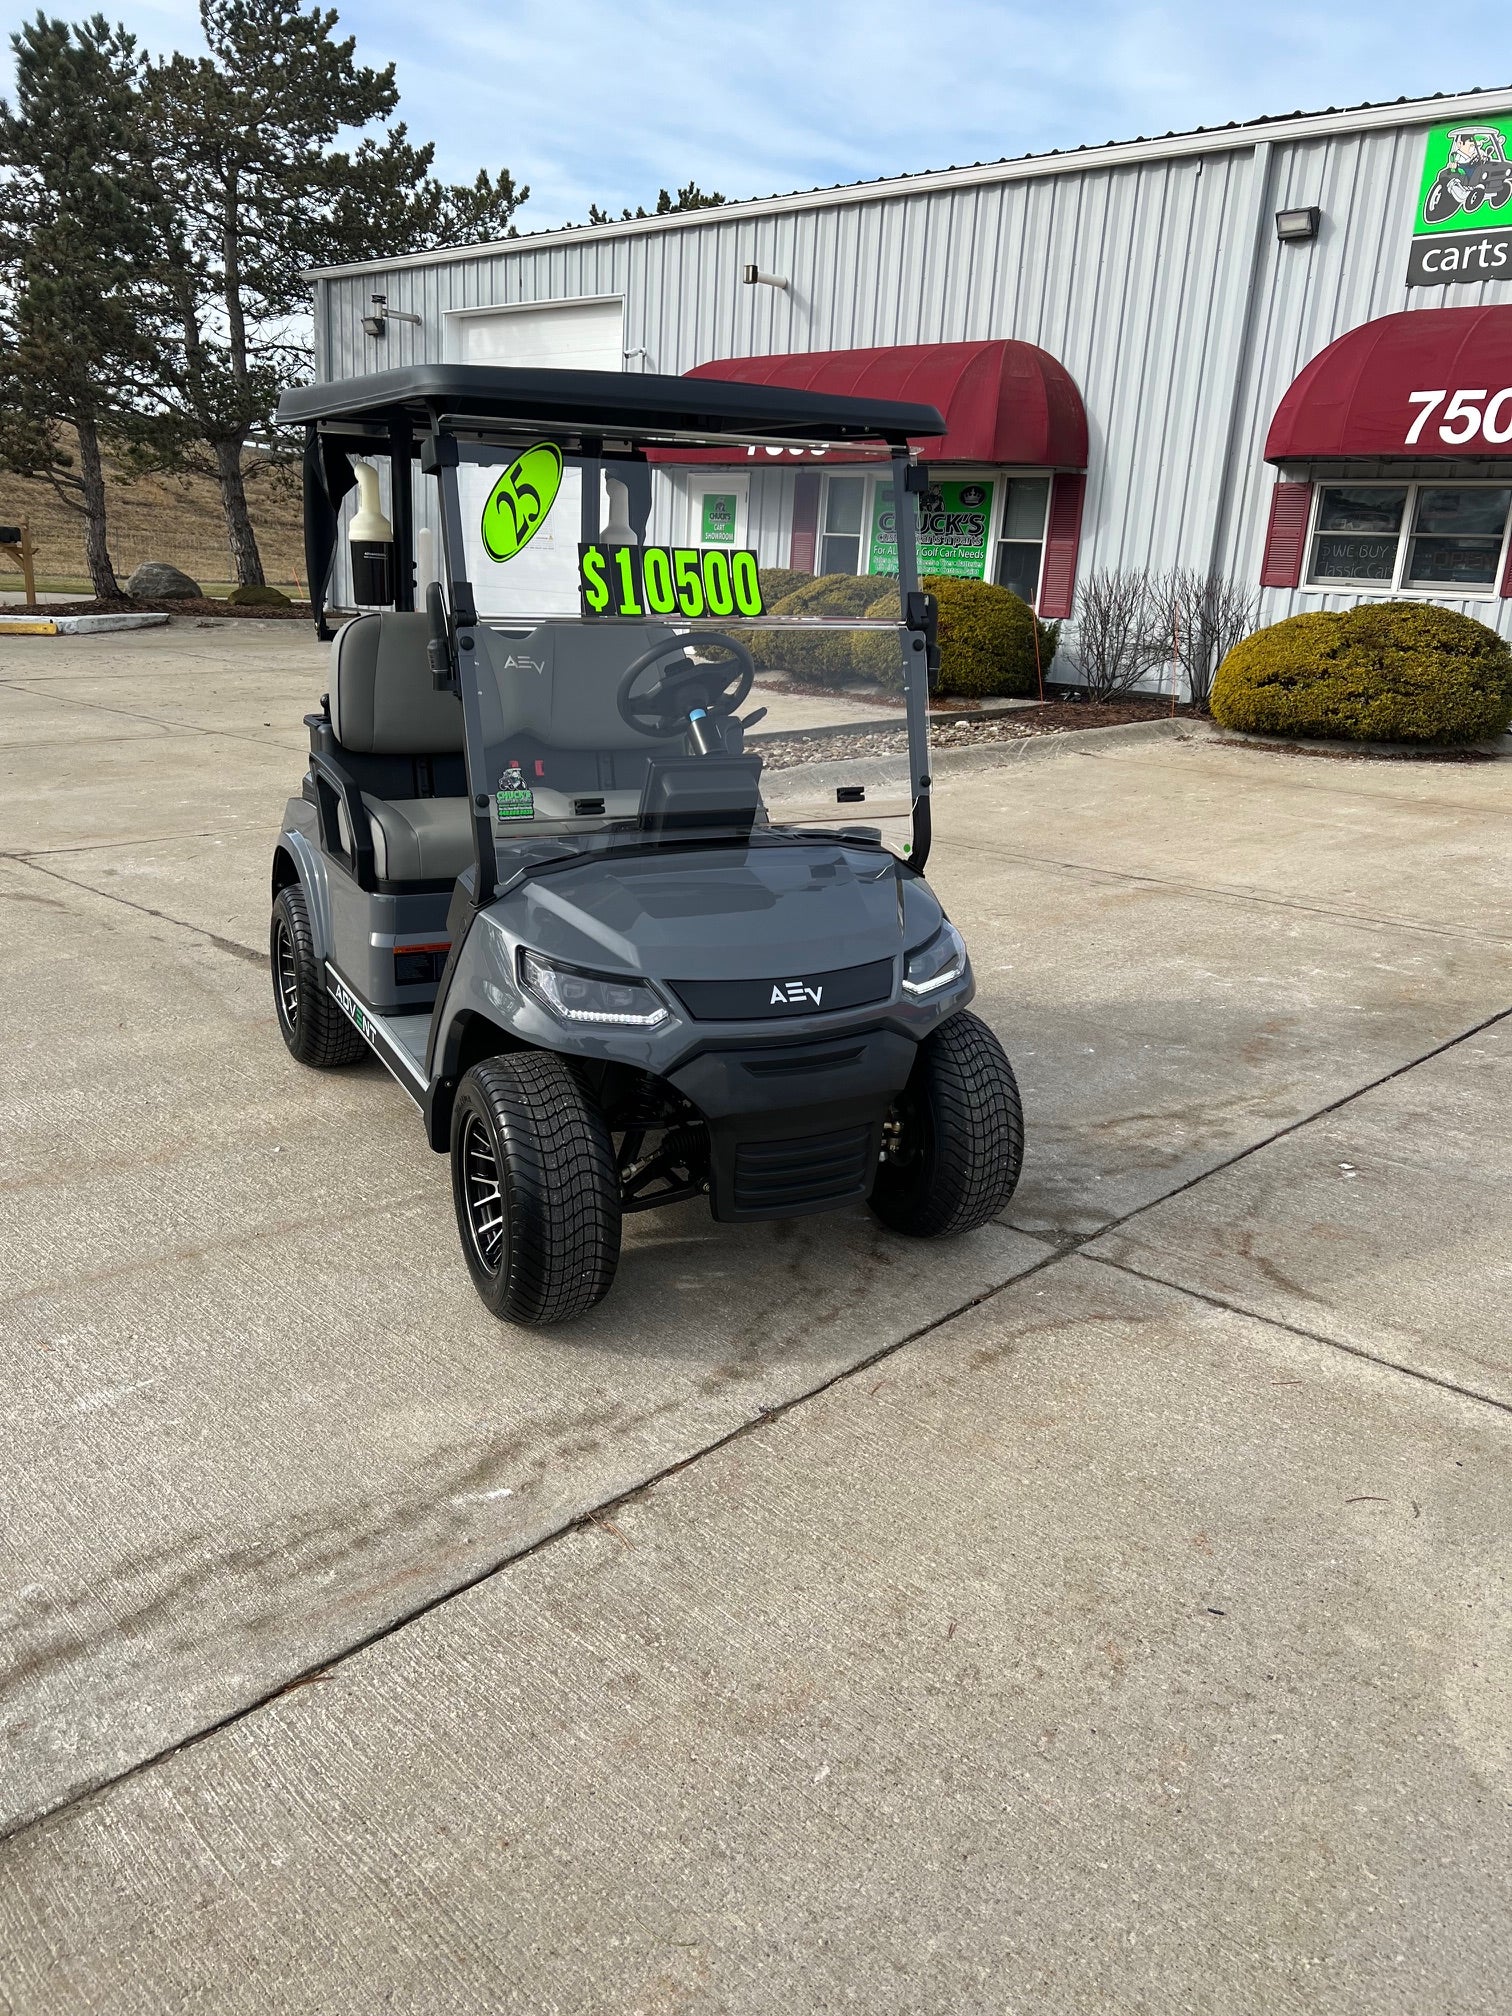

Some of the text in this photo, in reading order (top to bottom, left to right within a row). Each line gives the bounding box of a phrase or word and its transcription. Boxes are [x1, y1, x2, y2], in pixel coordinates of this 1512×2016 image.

[1421, 239, 1508, 273] carts
[496, 463, 541, 546] 25
[878, 512, 986, 536] CUCK'S
[873, 545, 885, 555] For
[921, 547, 938, 557] Golf
[939, 548, 957, 558] Cart
[958, 549, 984, 559] Needs
[1332, 544, 1356, 558] WE
[1359, 545, 1389, 559] BUY
[582, 546, 763, 618] $10500
[504, 655, 546, 675] AEV
[769, 982, 823, 1007] AEV
[335, 984, 377, 1044] ADVENT
